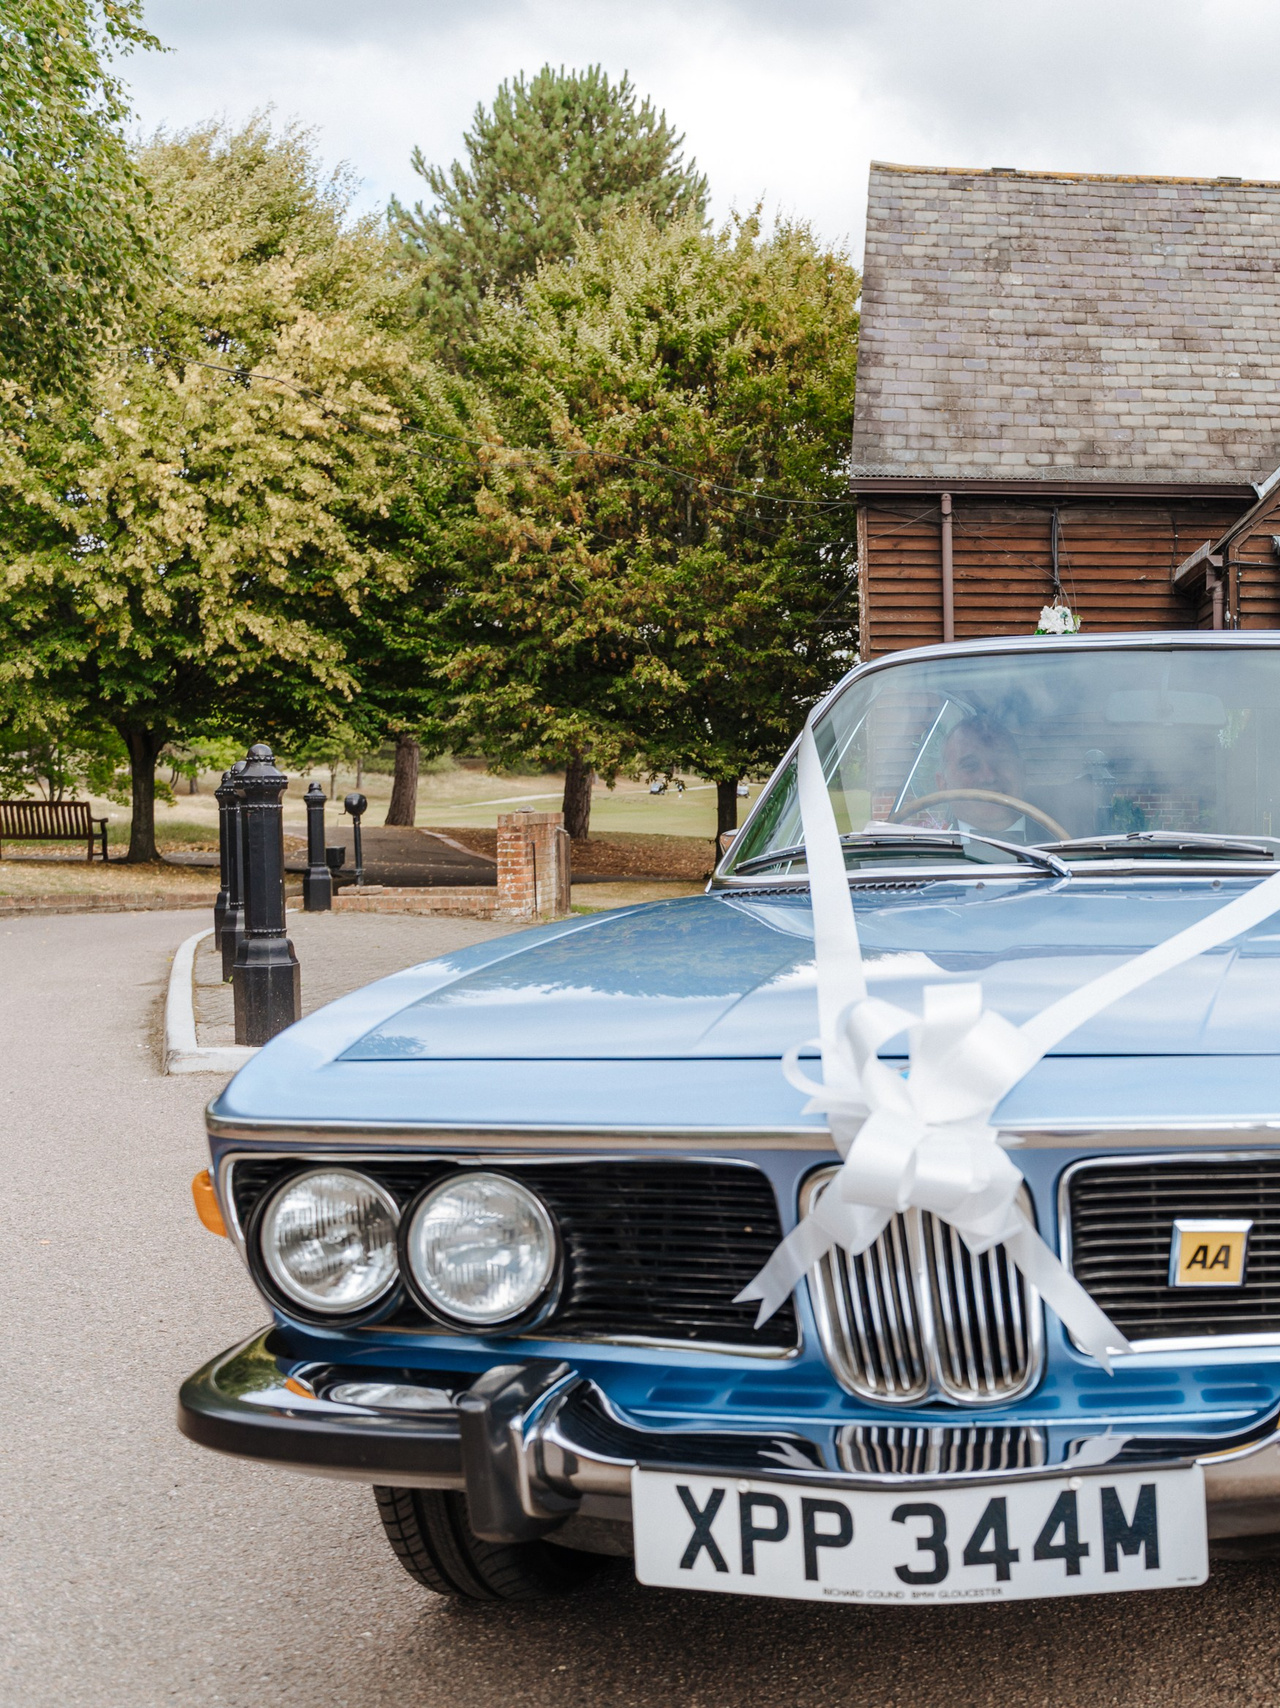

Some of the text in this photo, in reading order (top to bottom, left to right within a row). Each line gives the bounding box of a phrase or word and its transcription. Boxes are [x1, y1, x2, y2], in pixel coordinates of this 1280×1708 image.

[1186, 1245, 1231, 1270] AA
[676, 1483, 1160, 1585] XPP 344M
[938, 1586, 1003, 1599] GLOUCESTER
